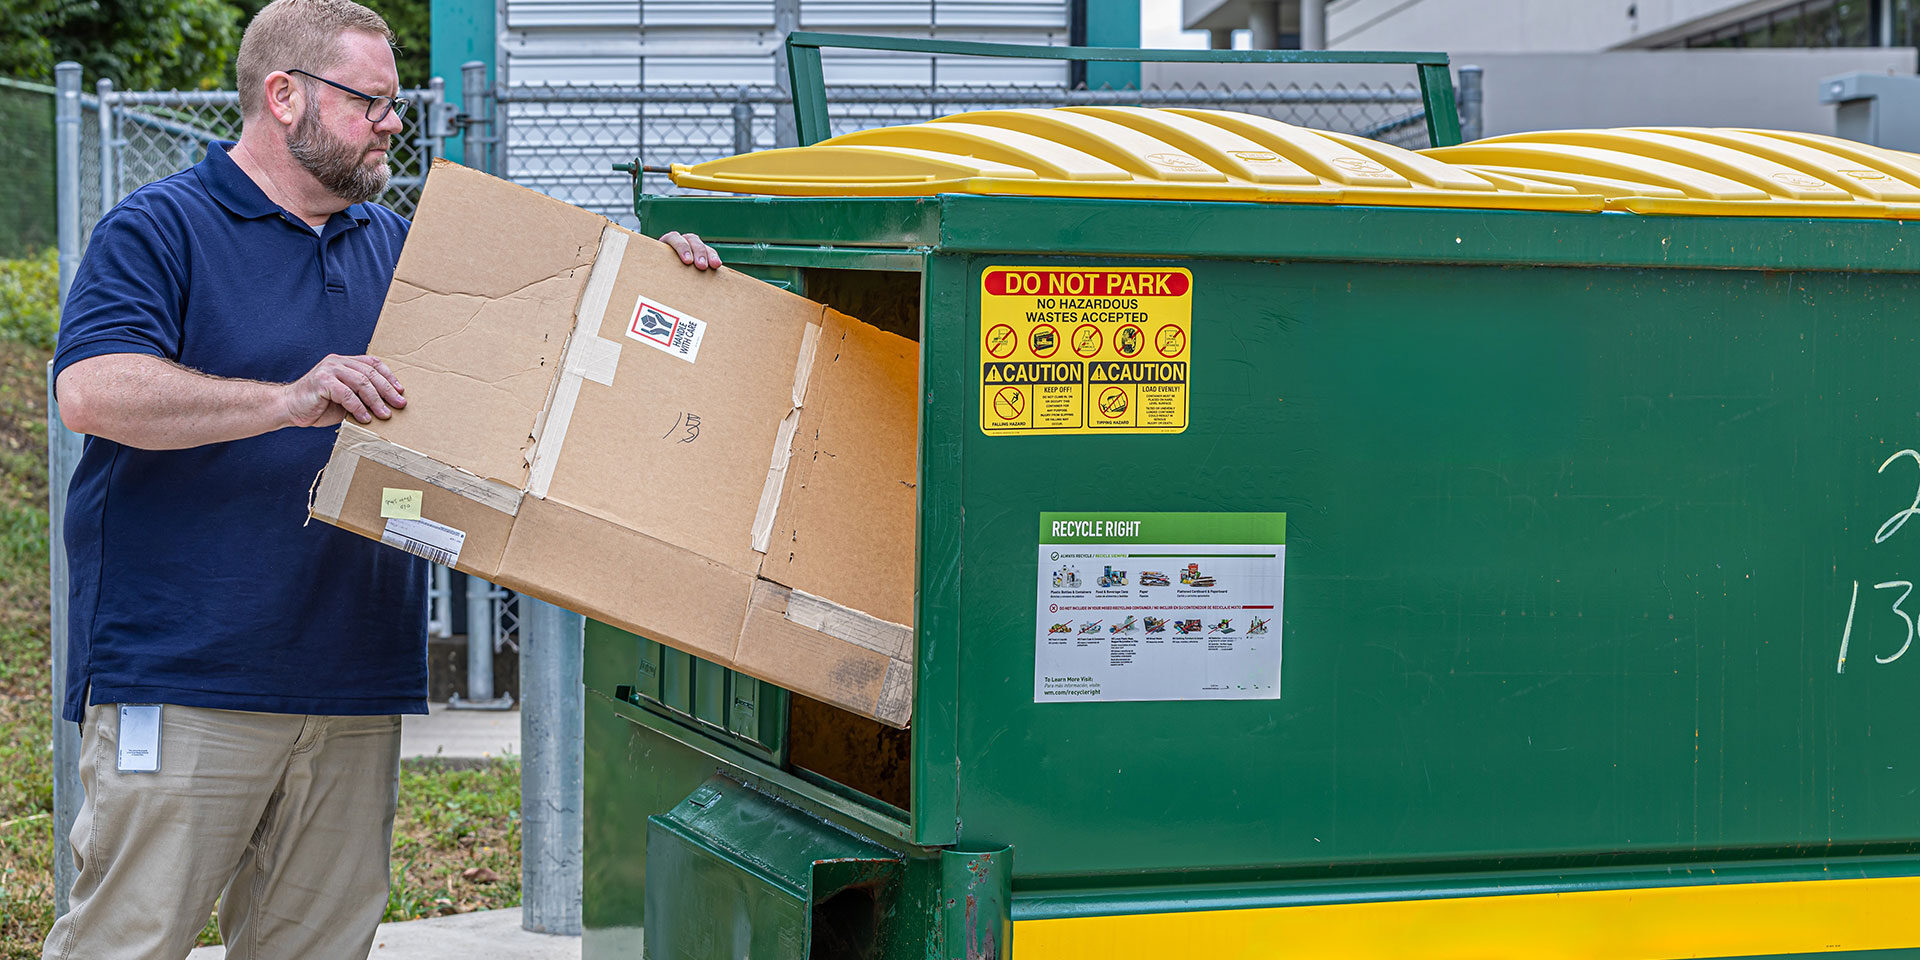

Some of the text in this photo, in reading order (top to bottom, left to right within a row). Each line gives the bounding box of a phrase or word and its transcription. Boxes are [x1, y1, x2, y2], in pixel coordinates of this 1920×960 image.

[1005, 273, 1172, 295] DO NOT PARK
[1037, 299, 1138, 309] NO HAZARDOUS
[1026, 312, 1148, 323] WASTES ACCEPTED
[673, 322, 687, 347] HANDLE
[680, 321, 697, 354] WITH CARE
[1003, 363, 1081, 382] CAUTION
[1108, 363, 1184, 382] CAUTION
[1052, 521, 1141, 536] RECYCLE RIGHT
[1837, 580, 1920, 674] 13
